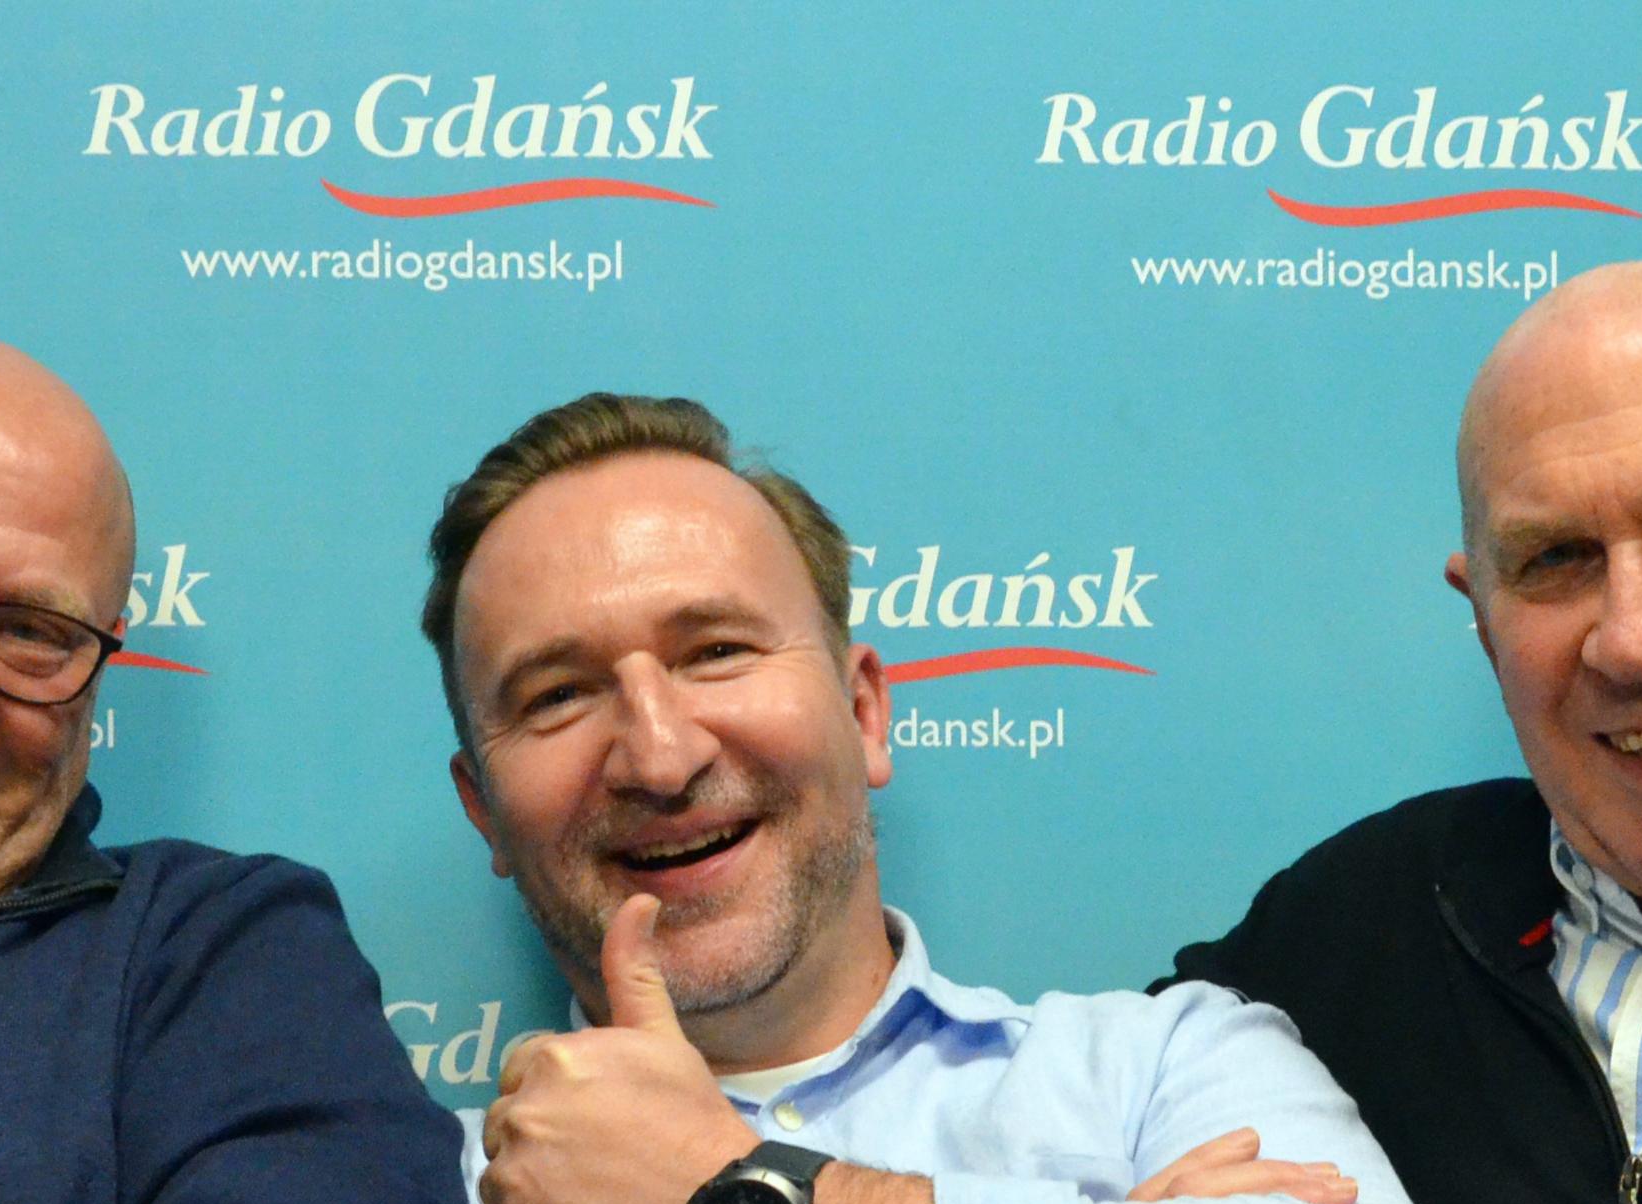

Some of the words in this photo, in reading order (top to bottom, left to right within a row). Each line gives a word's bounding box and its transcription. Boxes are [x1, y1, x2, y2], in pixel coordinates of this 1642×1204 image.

[84, 84, 331, 157] Radio
[355, 74, 717, 159] Gdańsk
[1037, 93, 1277, 167] Radio
[182, 239, 622, 291] www.radiogdansk.pl
[1131, 249, 1558, 299] www.radiogdansk.pl
[887, 707, 1064, 758] dansk.pl
[384, 1001, 555, 1083] Gd
